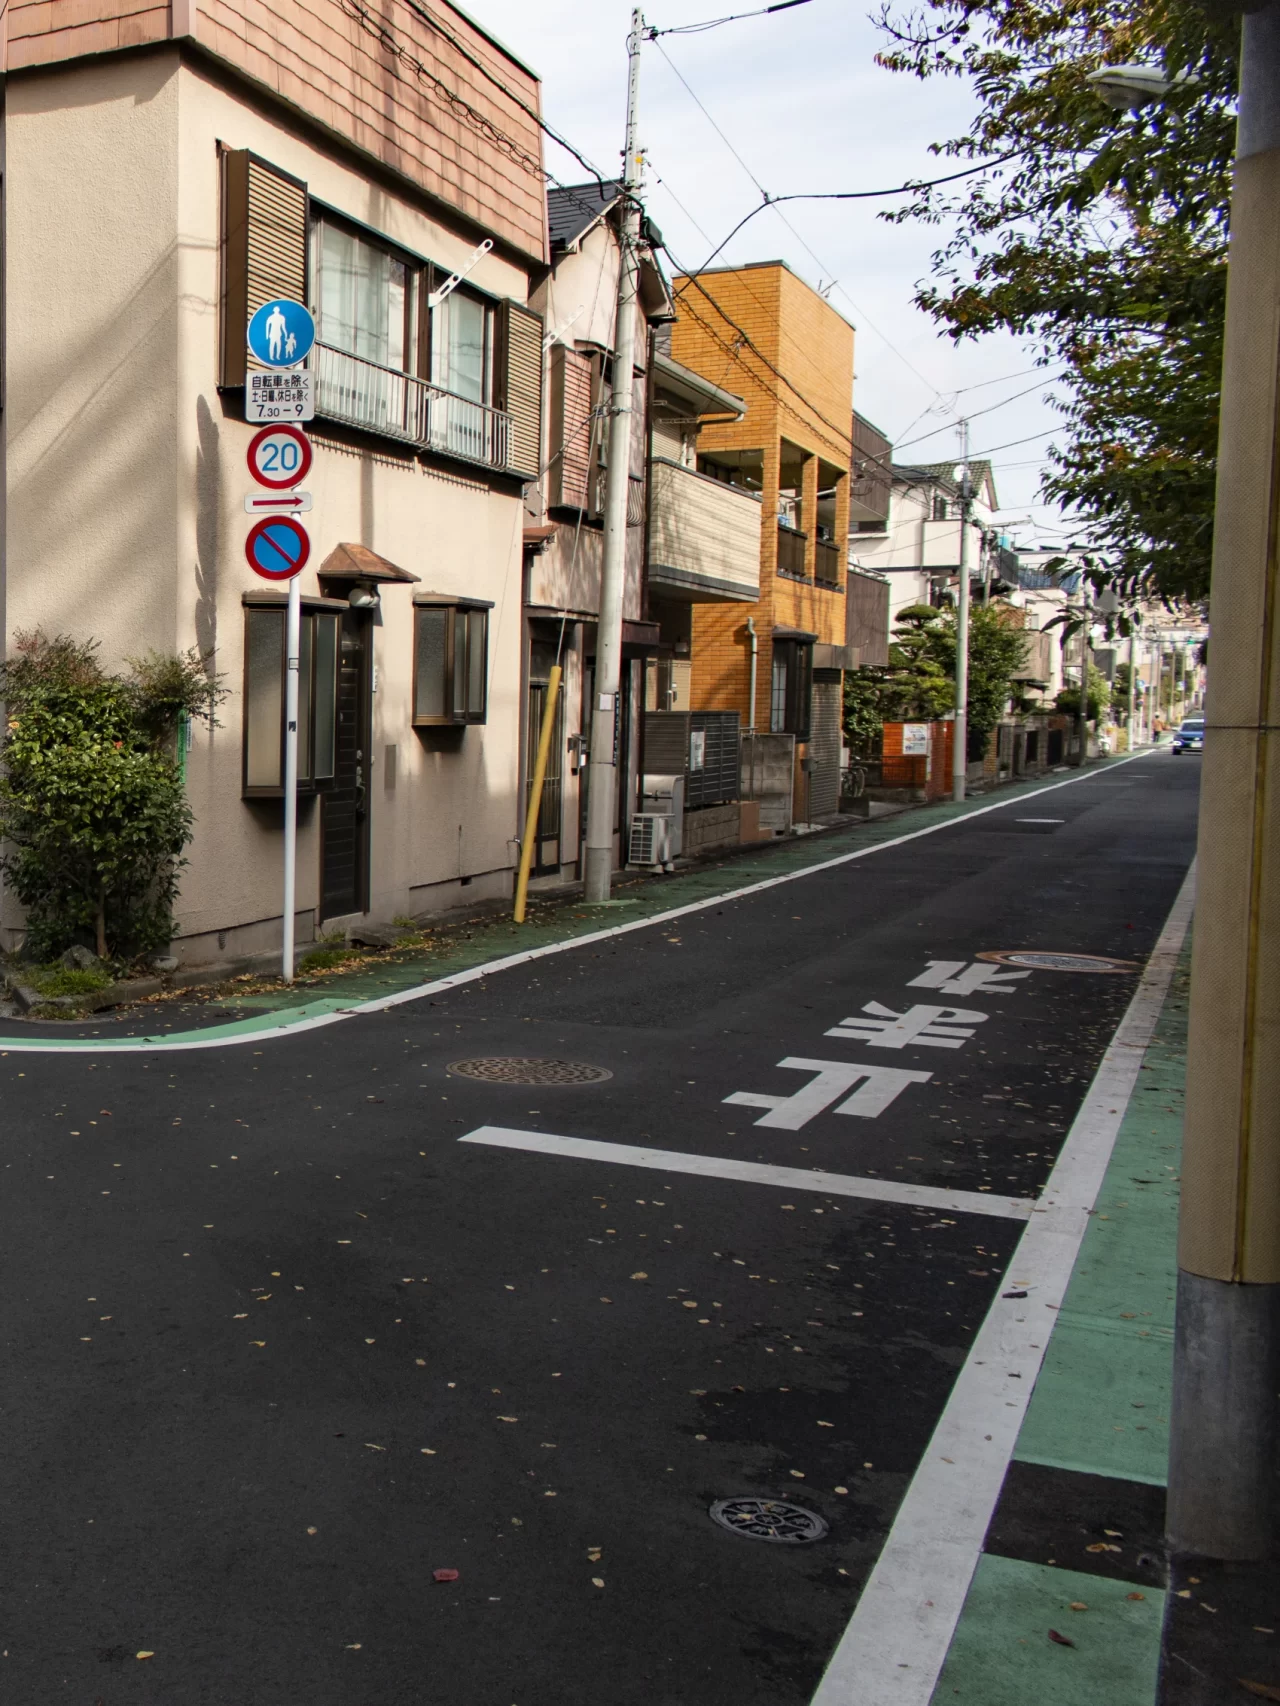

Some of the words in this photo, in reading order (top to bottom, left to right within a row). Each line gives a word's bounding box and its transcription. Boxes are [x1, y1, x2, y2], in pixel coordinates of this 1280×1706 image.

[252, 374, 308, 388] 自転車を除く
[261, 442, 298, 472] 20
